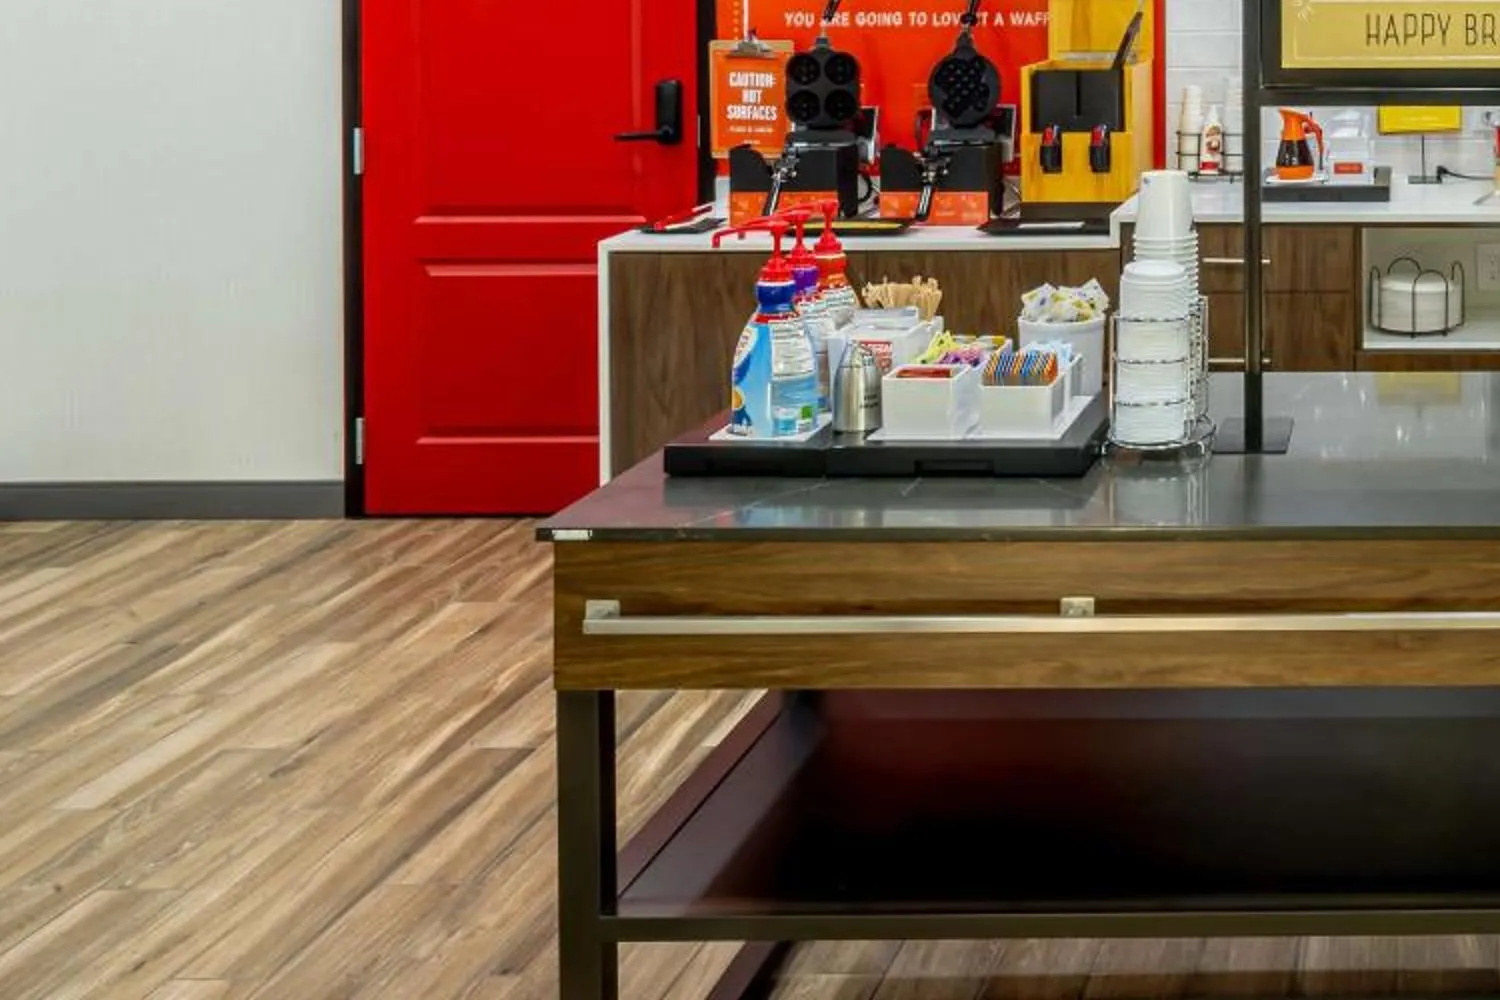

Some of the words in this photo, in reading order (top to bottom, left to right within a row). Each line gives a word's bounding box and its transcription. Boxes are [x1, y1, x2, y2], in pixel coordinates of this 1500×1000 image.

[784, 12, 815, 27] YOU
[855, 12, 902, 27] GOING
[908, 12, 927, 27] TO
[932, 12, 965, 27] LOV
[993, 12, 1004, 27] A
[1365, 13, 1450, 46] HAPPY
[742, 89, 762, 104] HOT
[726, 104, 777, 121] SURFACES
